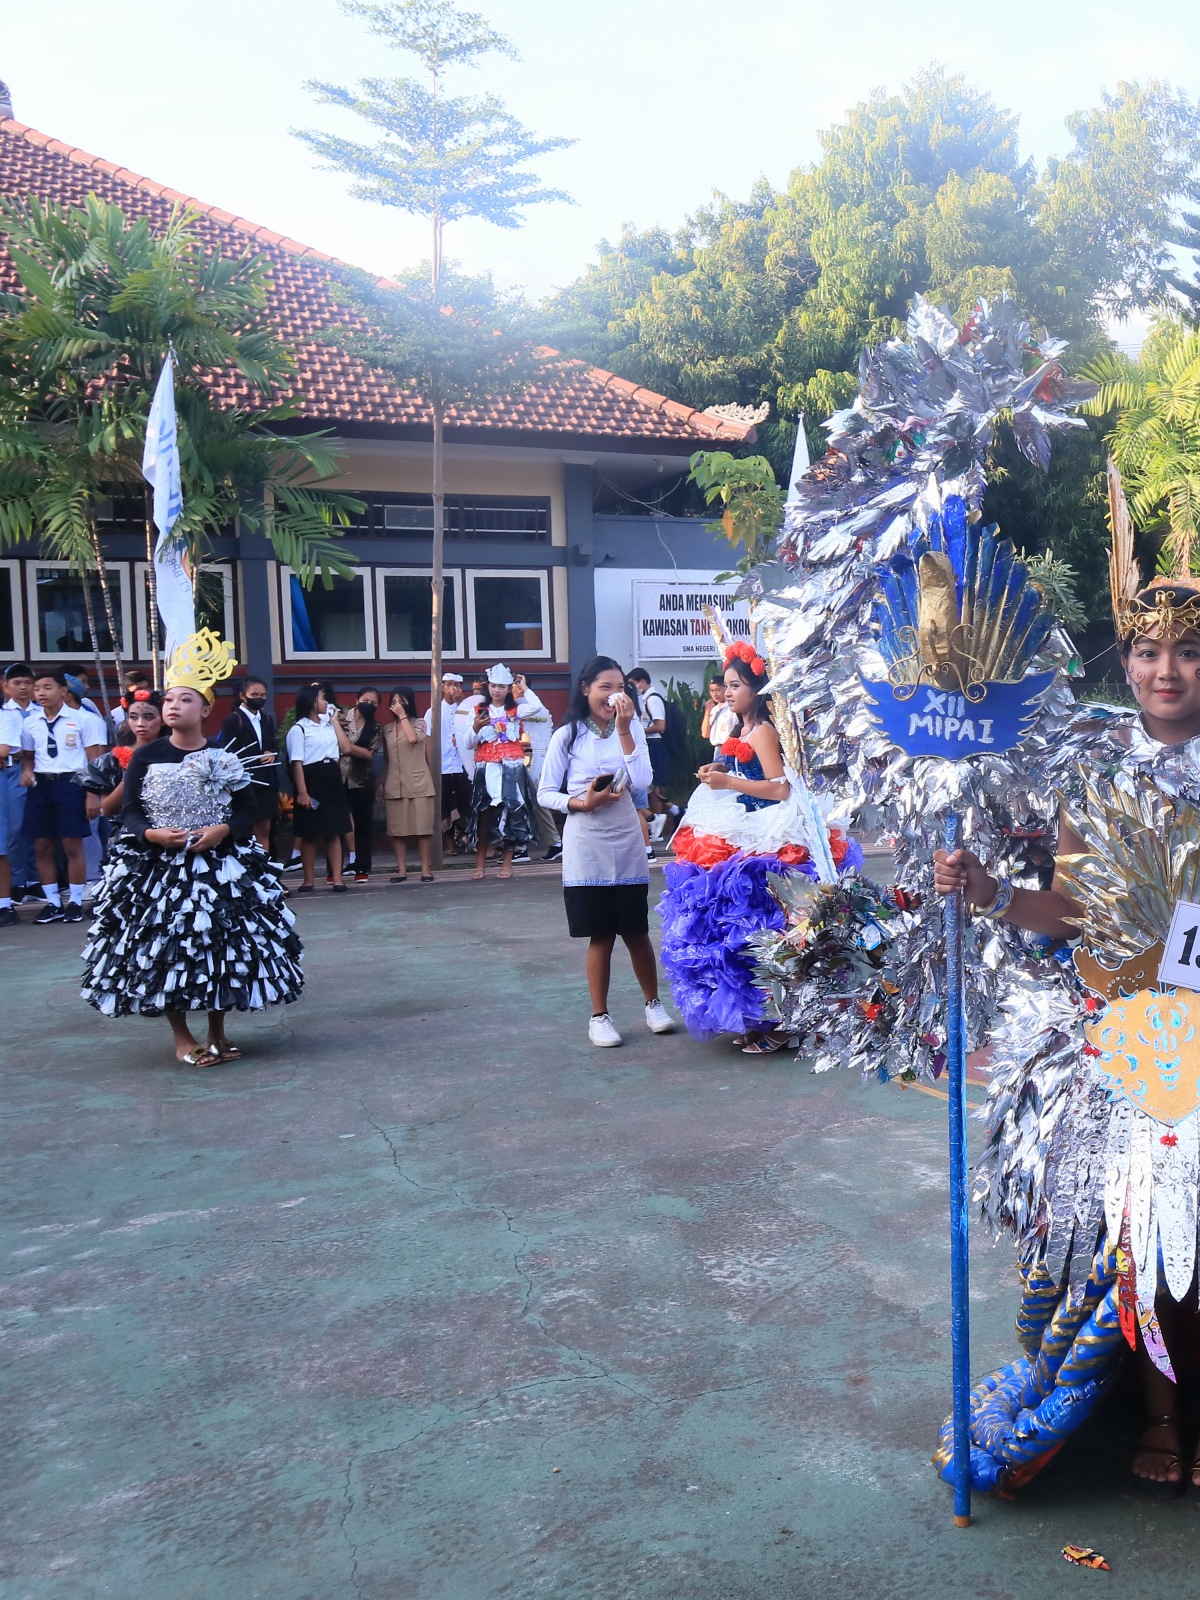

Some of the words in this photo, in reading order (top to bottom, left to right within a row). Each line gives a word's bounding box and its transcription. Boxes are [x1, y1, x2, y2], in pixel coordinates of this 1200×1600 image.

[659, 593, 684, 611] ANDA
[642, 618, 688, 636] KAWASAN
[726, 618, 751, 636] OKOK
[922, 688, 966, 718] XII
